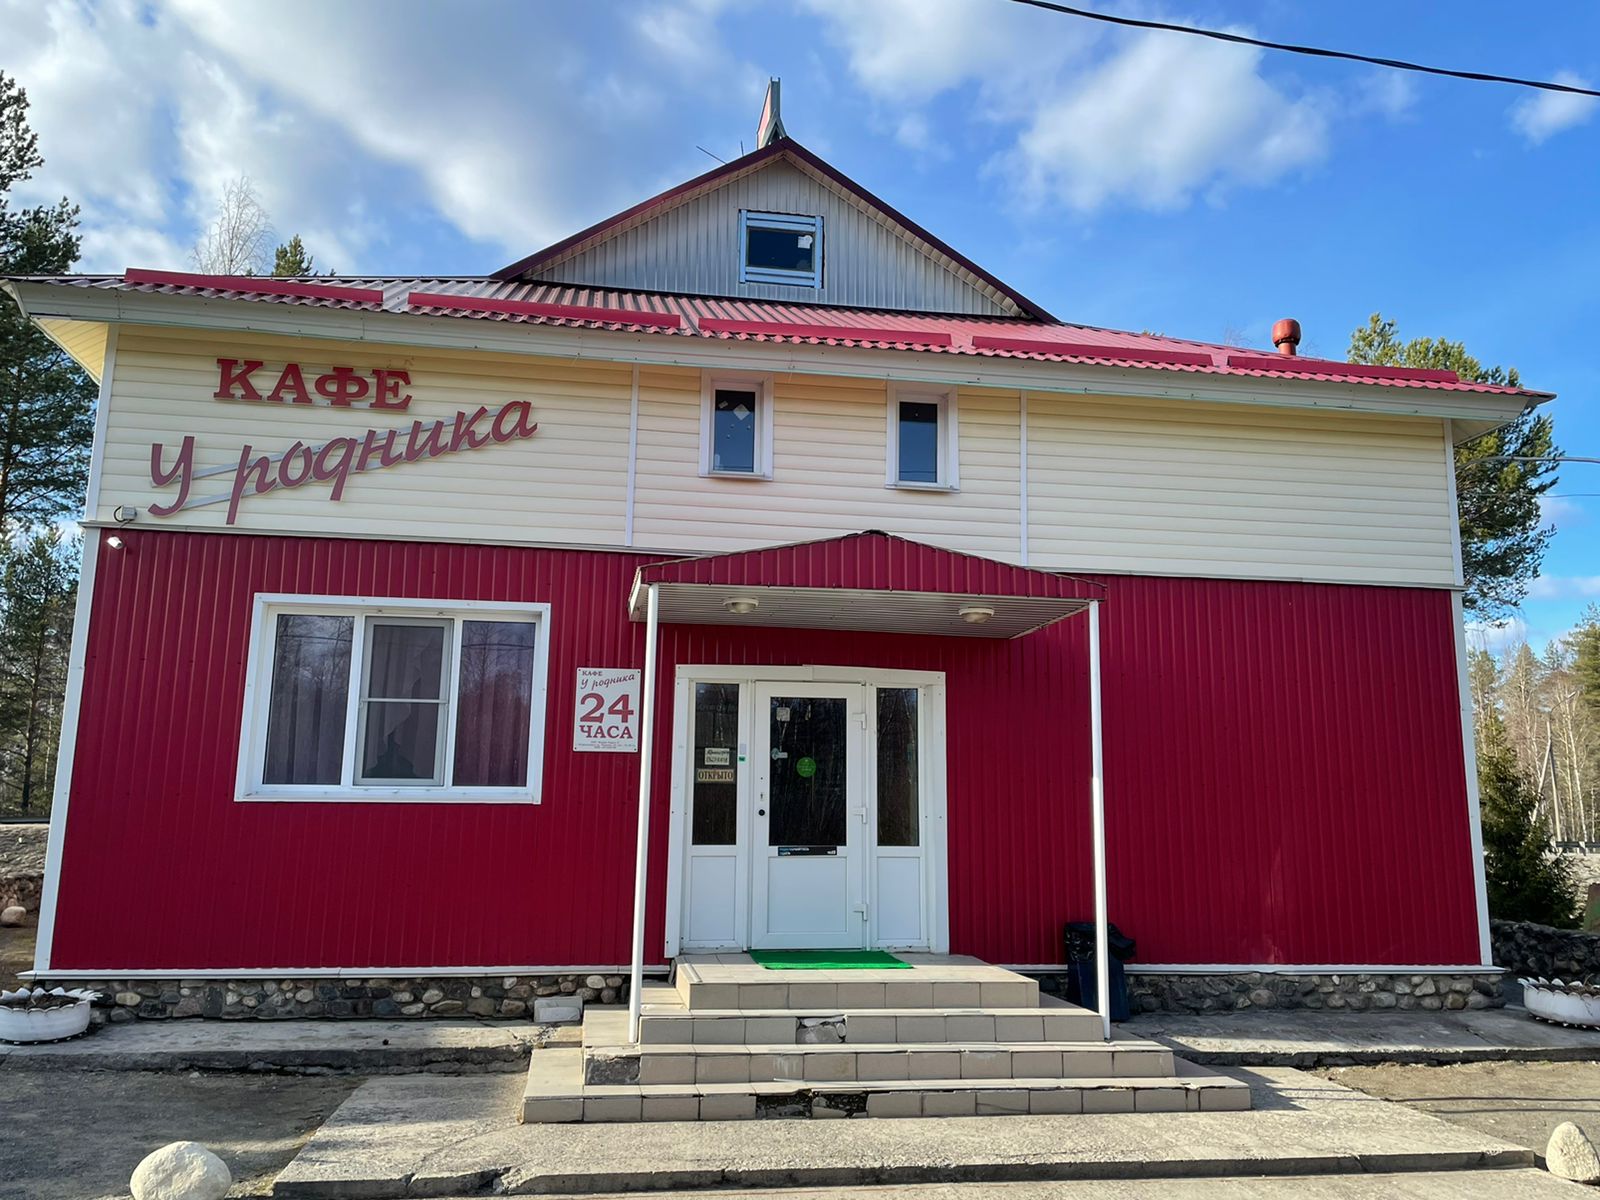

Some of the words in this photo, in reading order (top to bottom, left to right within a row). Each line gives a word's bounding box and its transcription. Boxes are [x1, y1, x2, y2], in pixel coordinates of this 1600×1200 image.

[213, 358, 412, 410] КАФЕ
[226, 400, 537, 525] родника
[592, 674, 634, 690] родника
[580, 693, 634, 723] 24
[579, 725, 633, 739] ЧАСА
[698, 771, 733, 780] ОТКРЫТО
